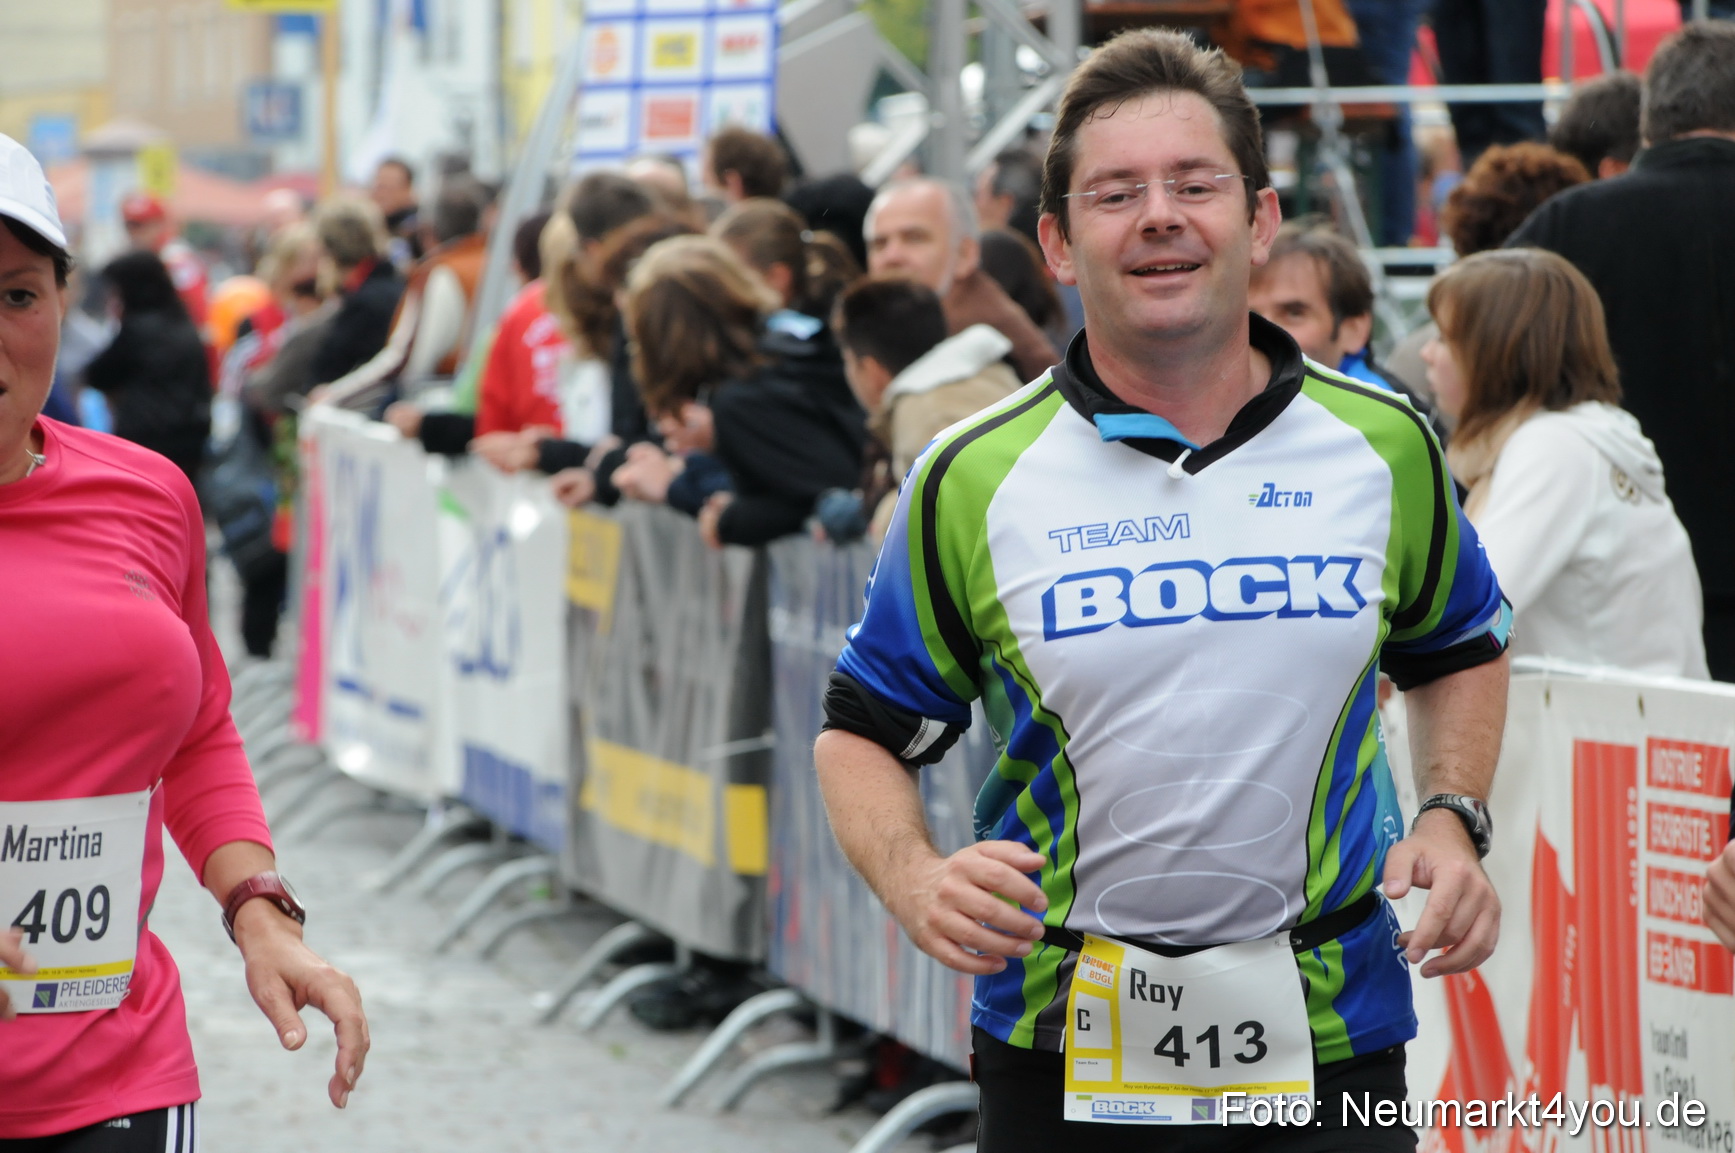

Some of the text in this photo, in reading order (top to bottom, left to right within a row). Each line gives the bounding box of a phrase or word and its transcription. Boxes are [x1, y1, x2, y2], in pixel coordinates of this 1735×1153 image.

[1048, 513, 1191, 554] TEAM
[1041, 555, 1368, 642] BOCK
[1, 825, 103, 863] Martina
[10, 884, 111, 944] 409
[1089, 970, 1113, 985] BÜGL
[1129, 967, 1184, 1011] Roy
[1077, 1008, 1091, 1031] C
[1153, 1020, 1268, 1069] 413
[1092, 1100, 1155, 1114] BOCK
